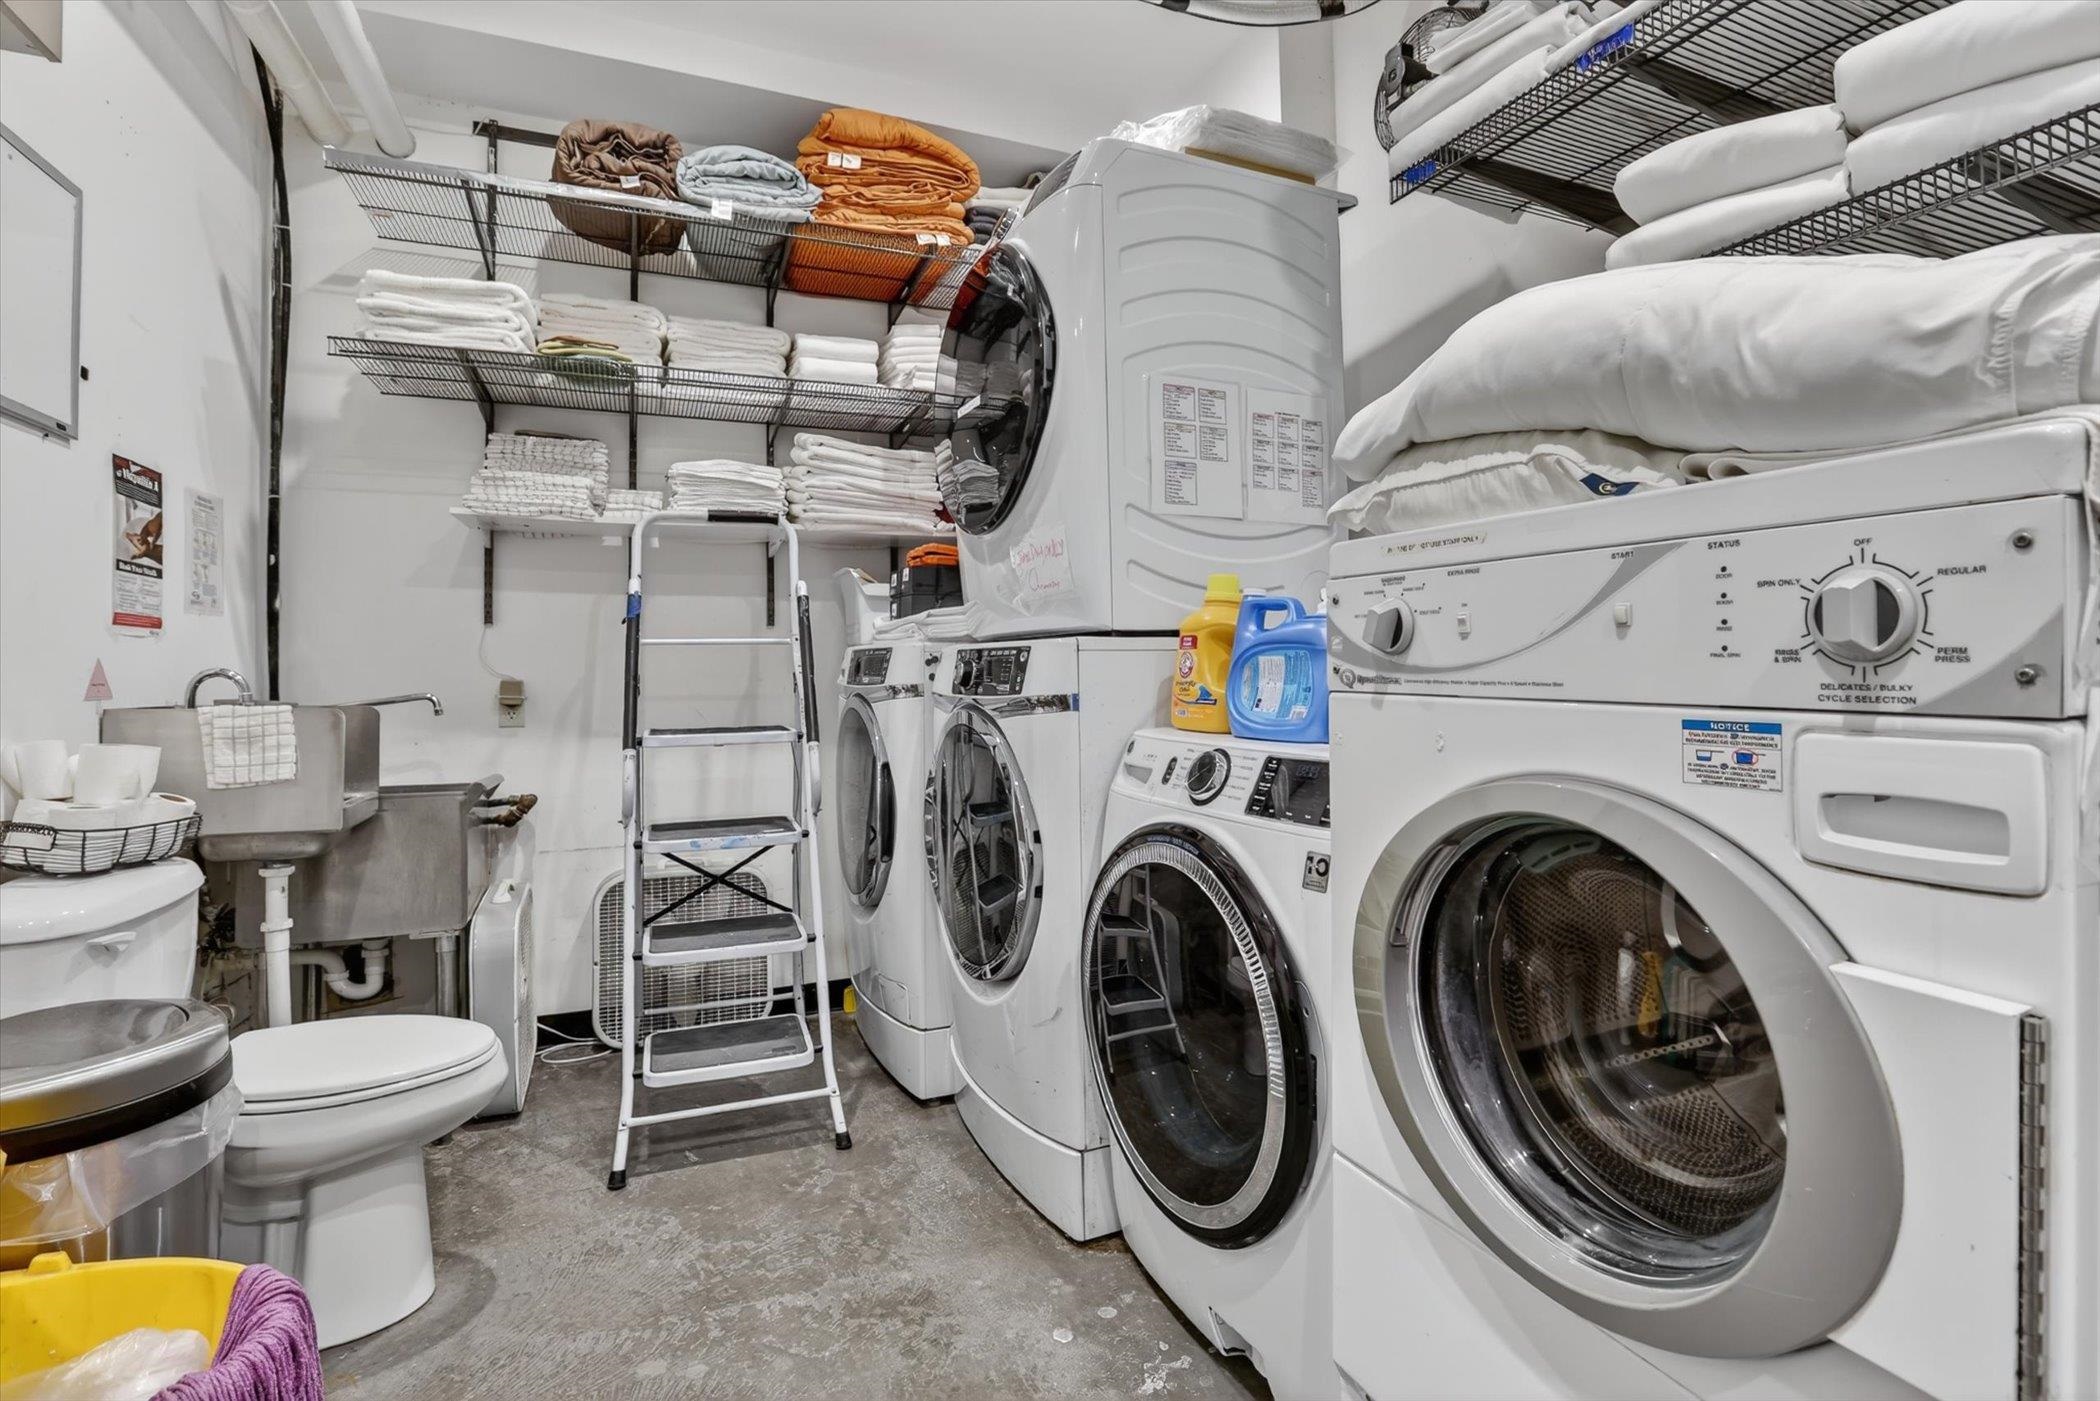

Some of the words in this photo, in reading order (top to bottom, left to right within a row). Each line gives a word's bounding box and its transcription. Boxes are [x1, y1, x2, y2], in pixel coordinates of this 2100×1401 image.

[1708, 539, 1741, 550] STATUS
[1853, 537, 1873, 547] OFF
[1611, 551, 1634, 560] START
[1937, 564, 1987, 576] REGULAR
[1757, 580, 1776, 588] SPIN
[1777, 579, 1801, 587] ONLY
[1937, 647, 1969, 655] PERM
[1934, 654, 1971, 664] PRESS
[1820, 683, 1872, 692] DELICATES
[1879, 683, 1913, 692] BULKY
[1817, 694, 1853, 703] CYCLE
[1854, 694, 1917, 705] SELECTION
[1710, 722, 1750, 732] NOTICE
